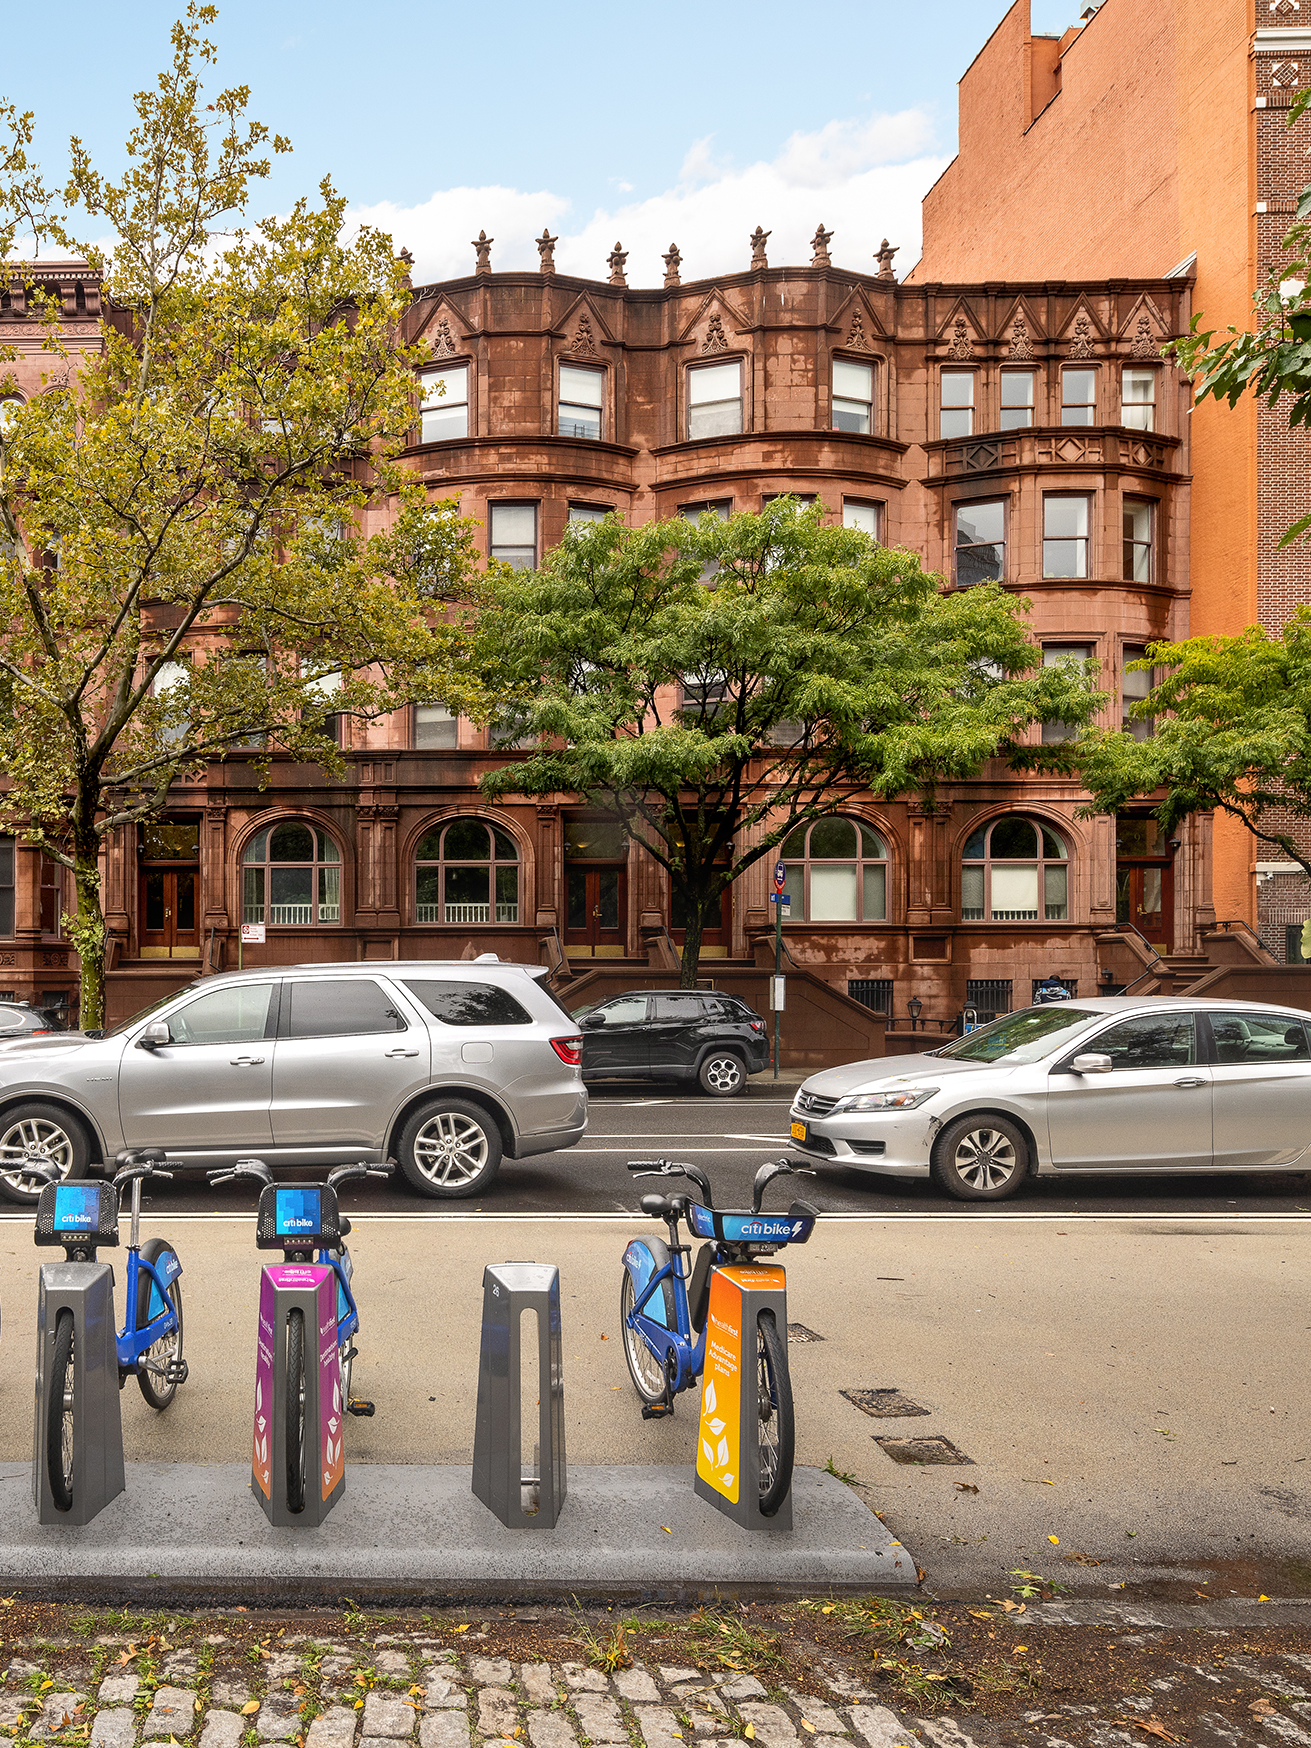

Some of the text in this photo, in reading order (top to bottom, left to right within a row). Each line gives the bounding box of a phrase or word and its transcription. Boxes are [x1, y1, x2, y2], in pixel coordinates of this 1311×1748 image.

[62, 1214, 92, 1223] citi bike
[283, 1218, 313, 1227] citi bike
[741, 1222, 790, 1234] citi bike
[711, 1340, 736, 1361] Medicare
[708, 1349, 737, 1372] Advantage
[715, 1363, 730, 1377] plans
